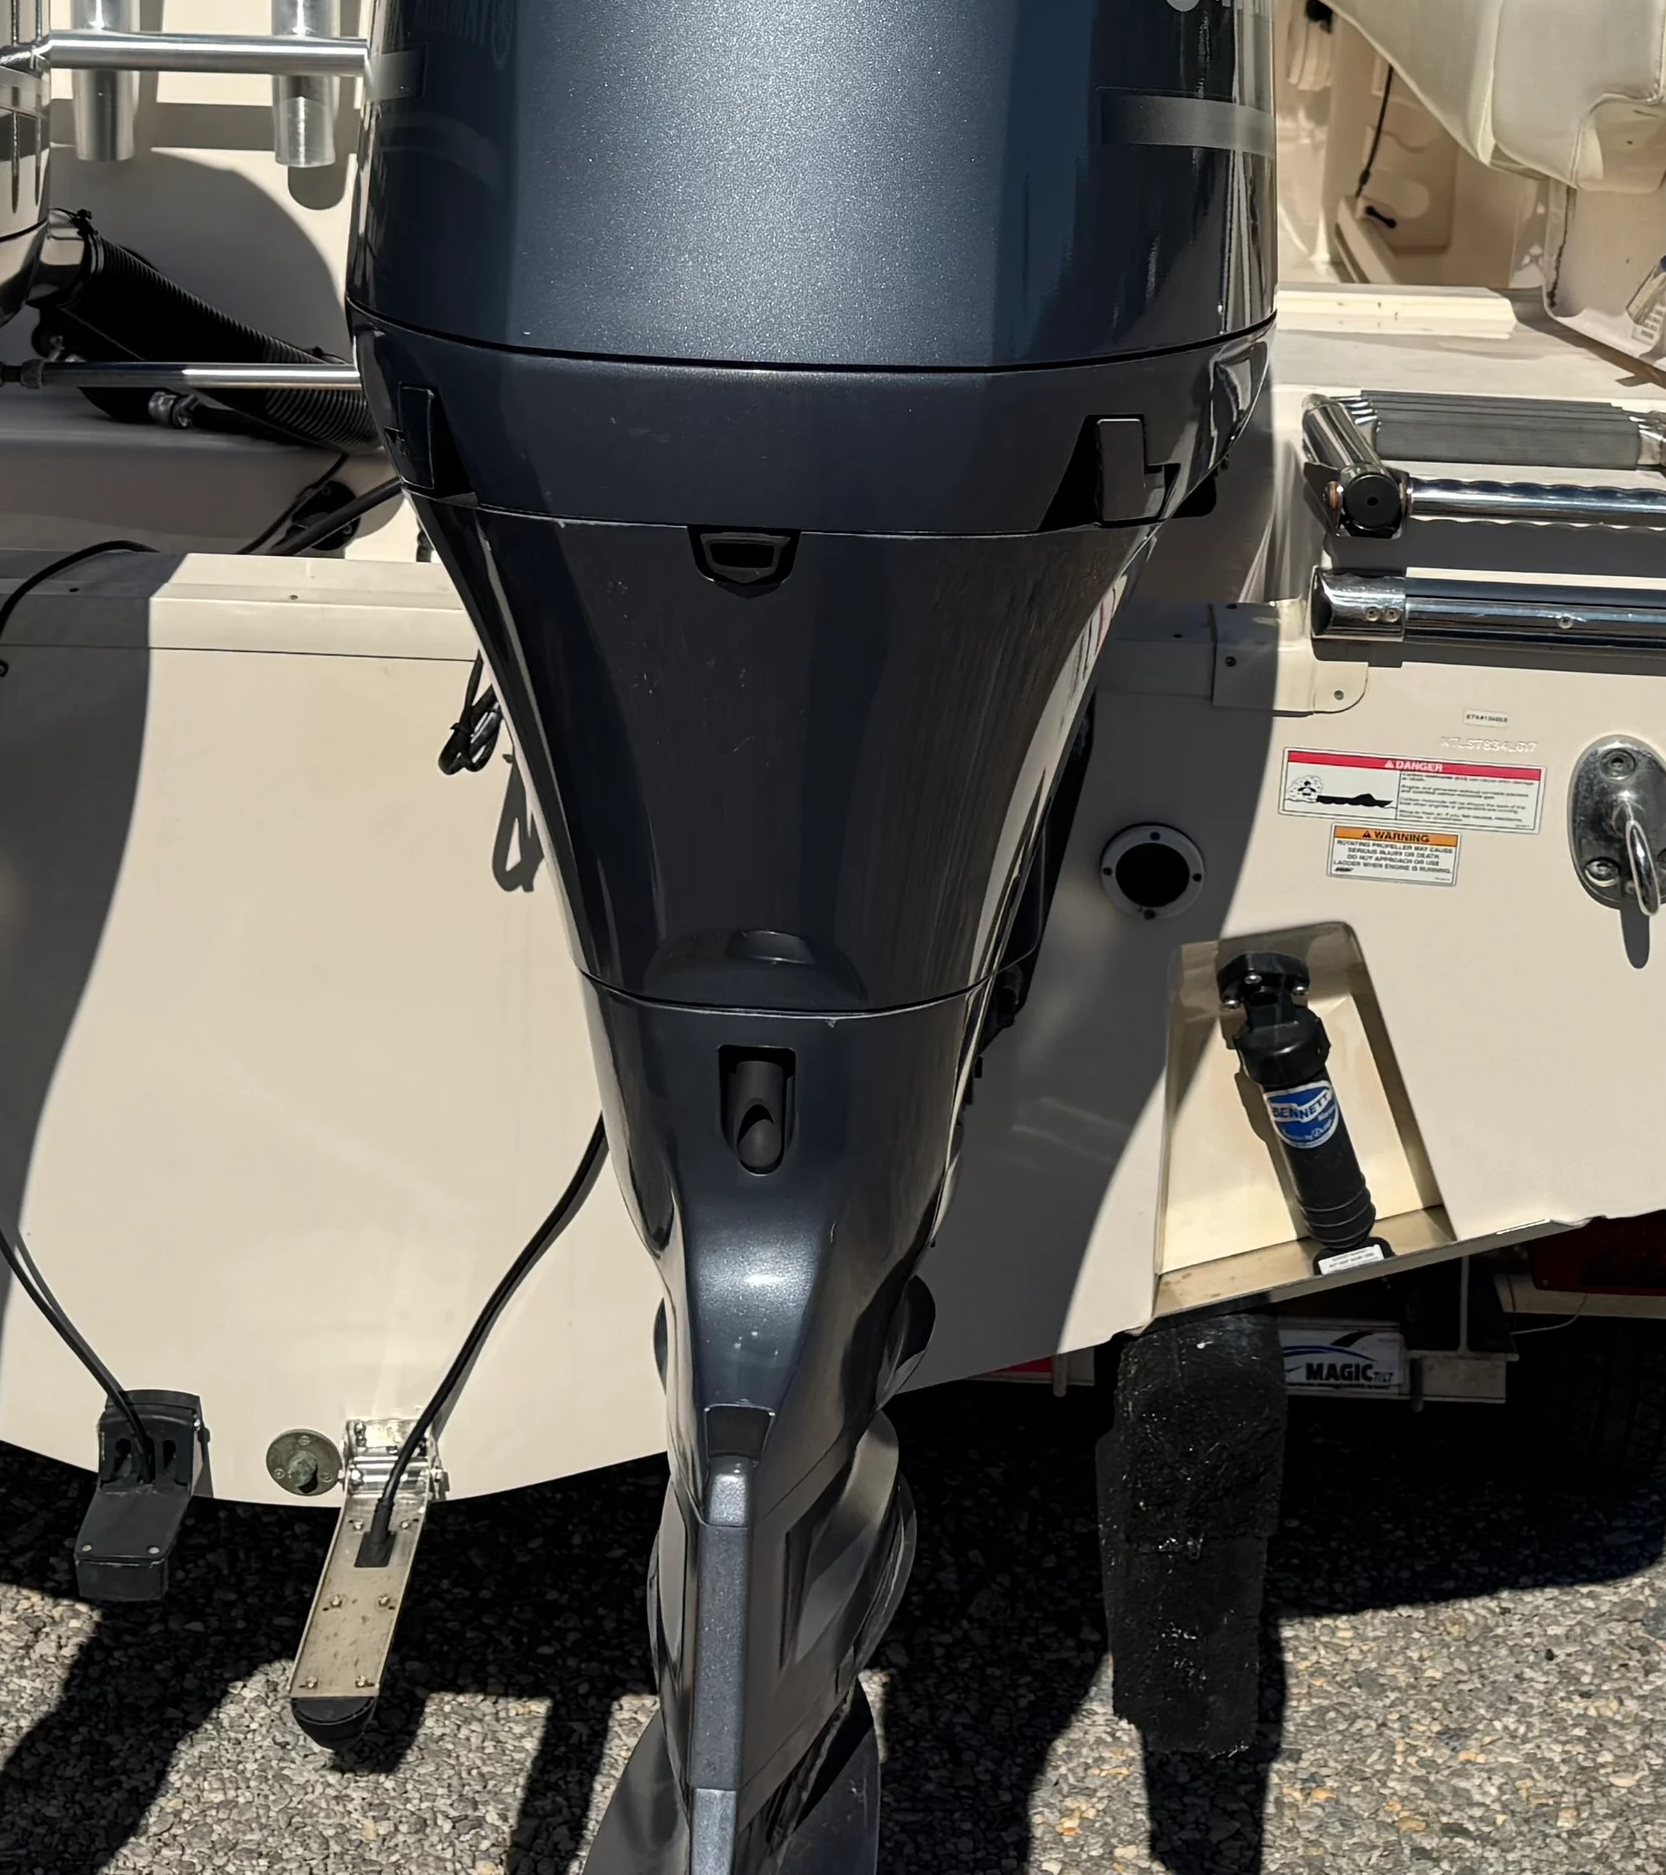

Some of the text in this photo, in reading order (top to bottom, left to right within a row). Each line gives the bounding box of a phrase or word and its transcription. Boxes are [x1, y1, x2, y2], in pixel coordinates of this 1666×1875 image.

[1395, 762, 1444, 772] DANGER
[1374, 830, 1430, 843] WARNING
[1347, 847, 1378, 855] SERIOUS
[1372, 842, 1413, 851] PROPELLER
[1333, 859, 1361, 867] LADDER
[1363, 861, 1383, 869] WHEN
[1384, 863, 1410, 871] ENGINE
[1374, 856, 1413, 864] APPROACH
[1272, 1092, 1329, 1120] BENNETT
[1305, 1362, 1374, 1382] MAGIC
